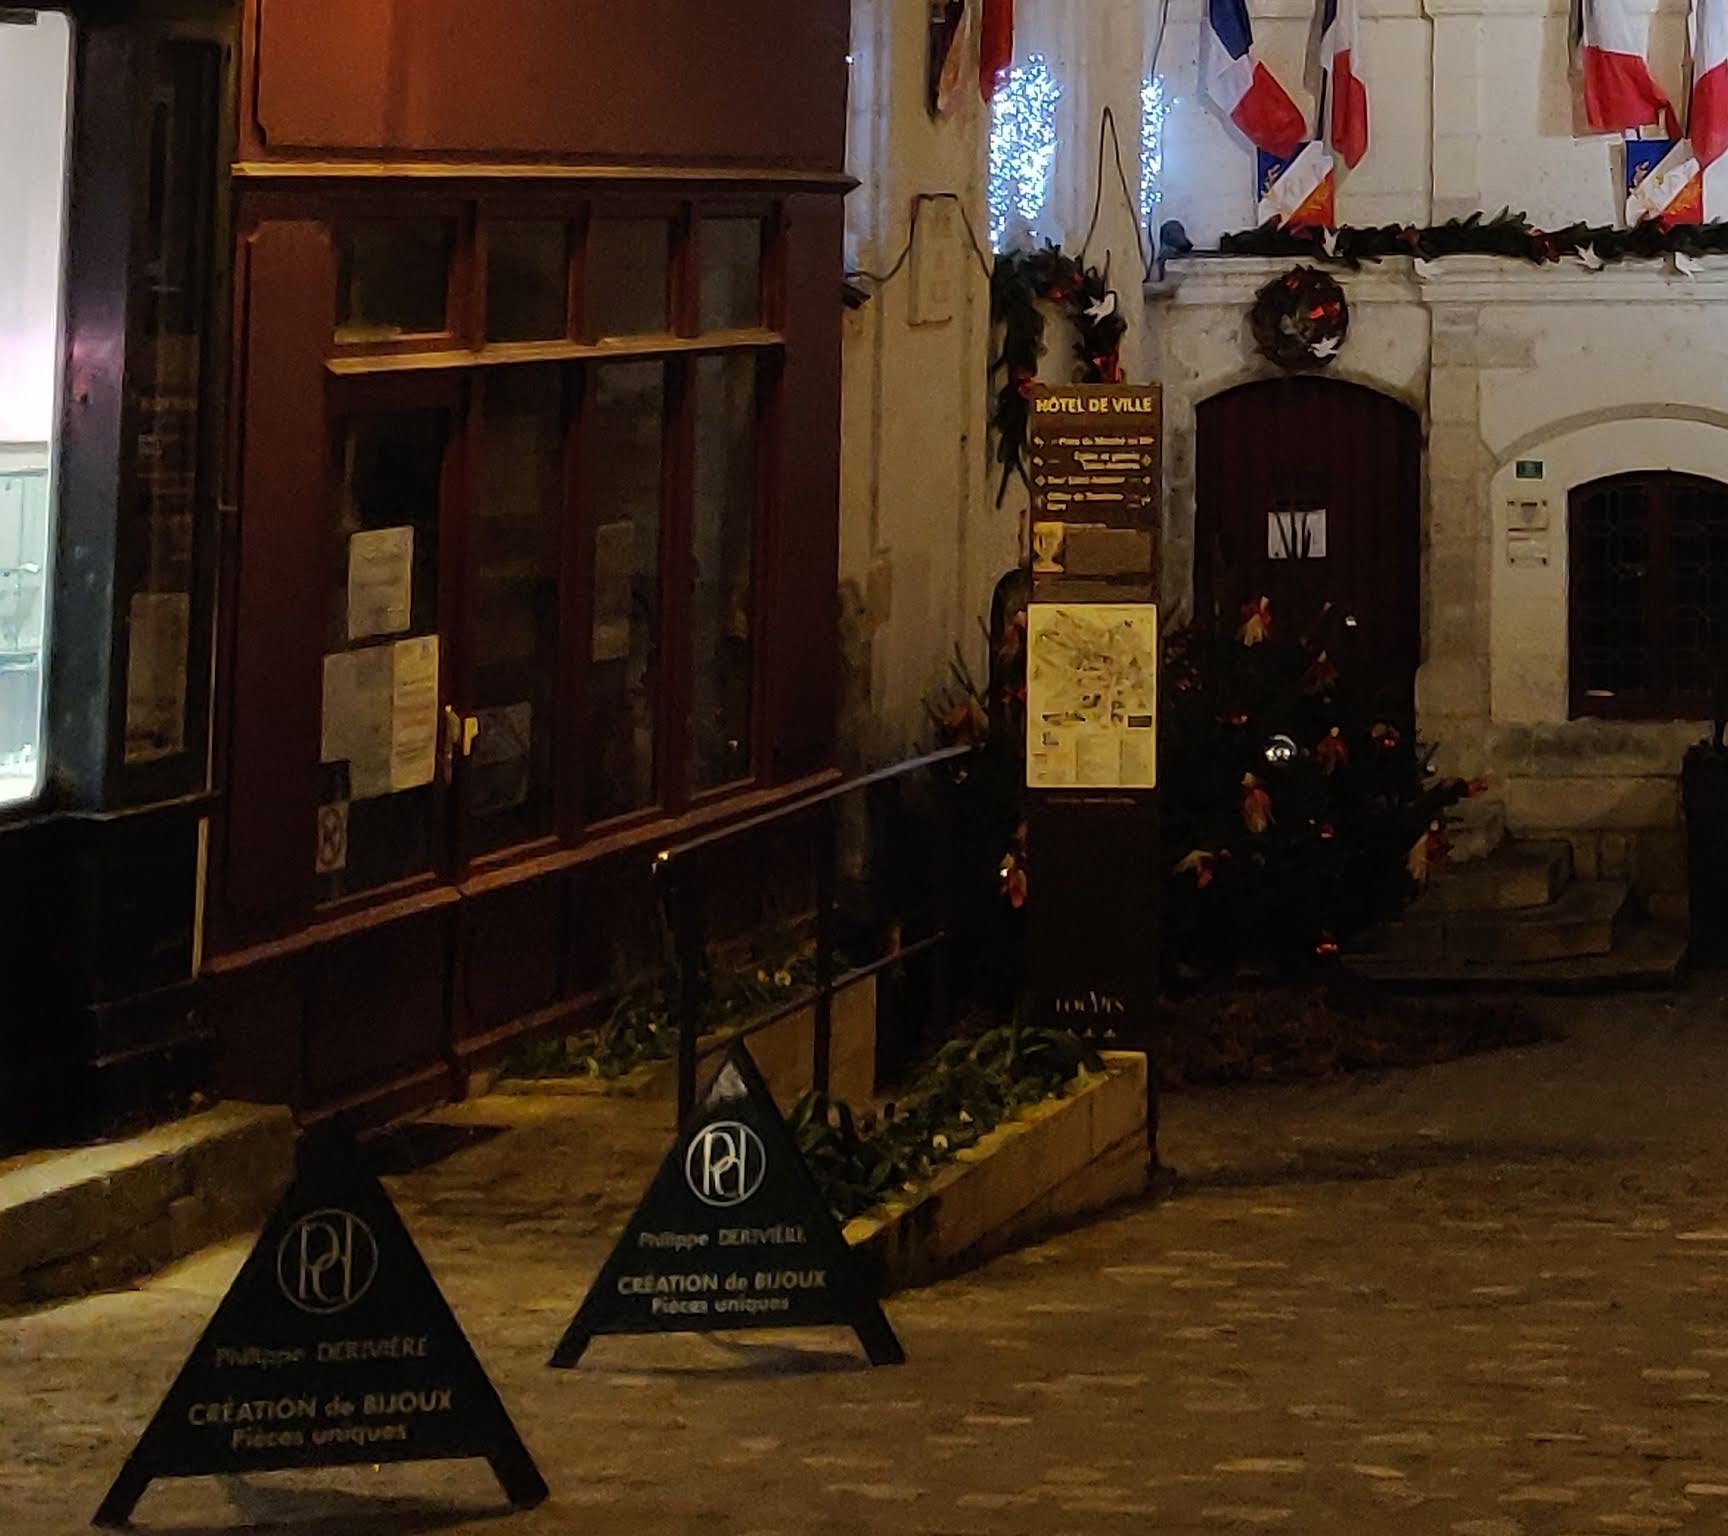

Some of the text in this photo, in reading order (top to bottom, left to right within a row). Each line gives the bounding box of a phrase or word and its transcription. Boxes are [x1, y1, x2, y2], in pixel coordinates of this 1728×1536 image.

[1035, 396, 1152, 413] HÔTEL DE VILLE
[724, 1274, 748, 1291] de
[754, 1269, 828, 1290] BIJOUX
[714, 1297, 791, 1315] uniques
[324, 1395, 356, 1419] de
[362, 1387, 453, 1416] BIJOUX
[311, 1423, 408, 1446] uniques
